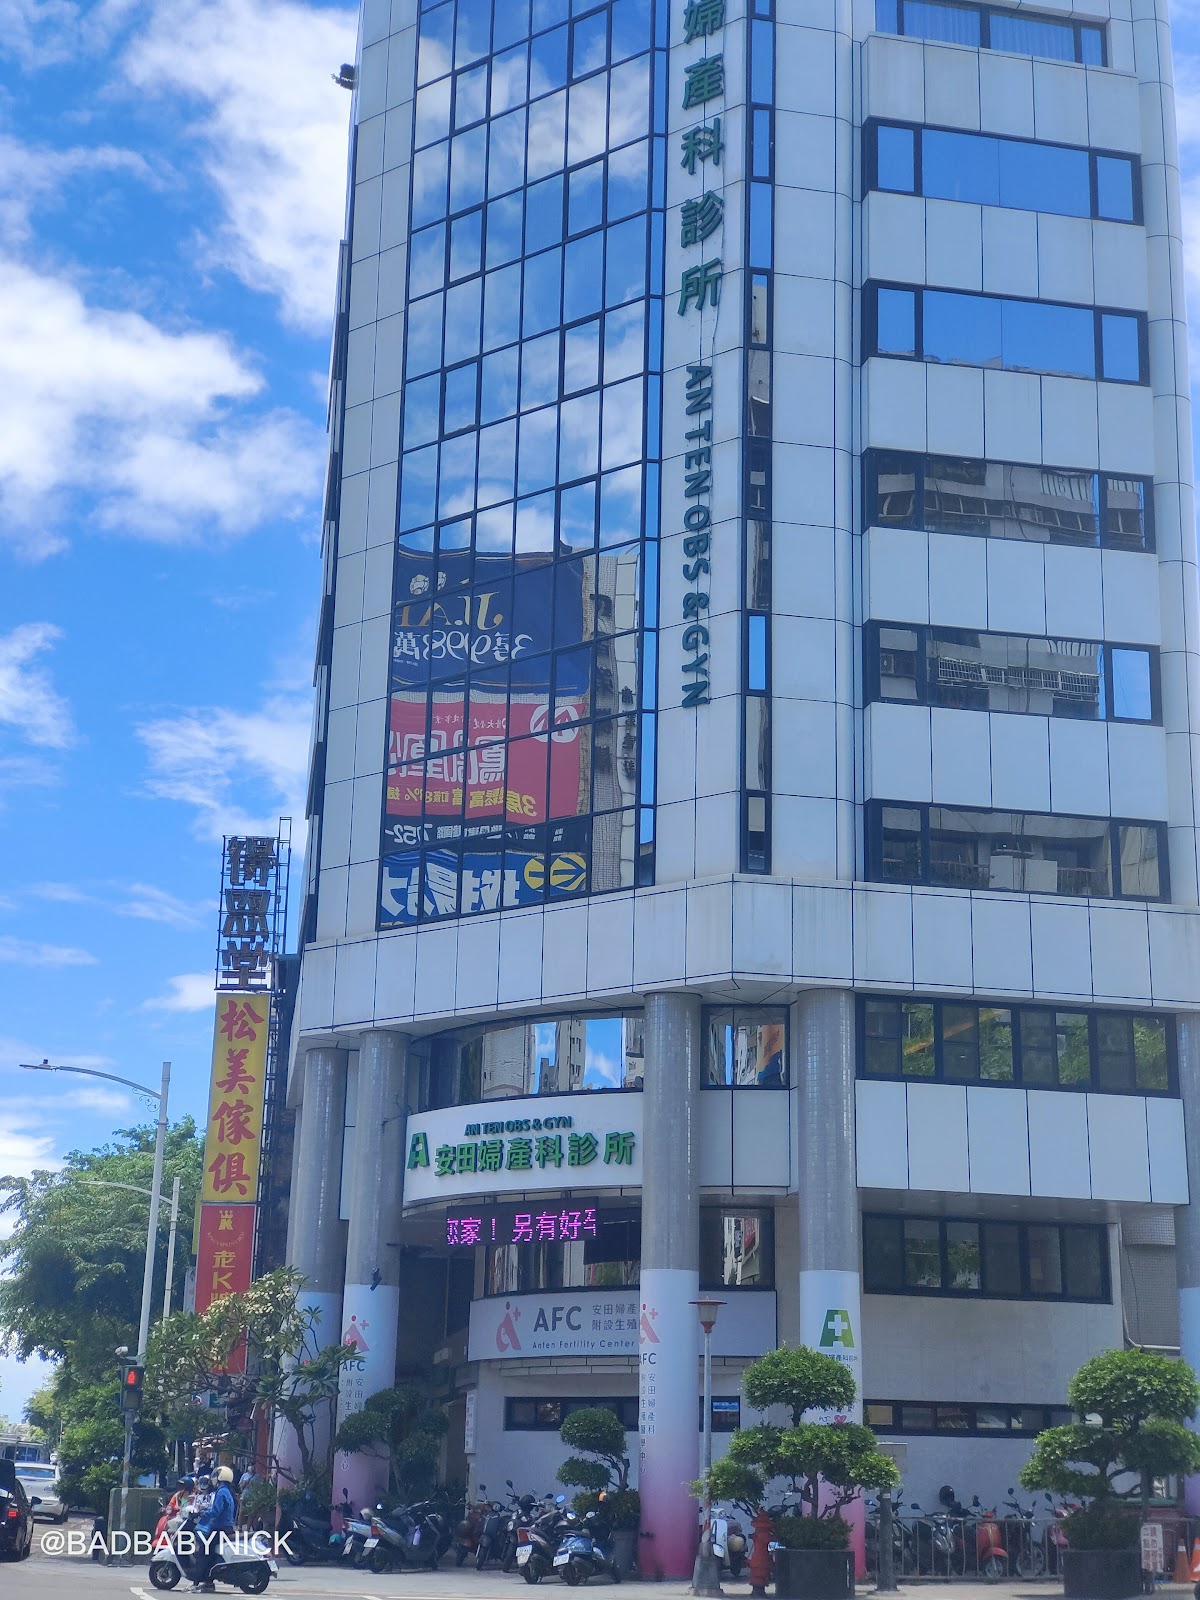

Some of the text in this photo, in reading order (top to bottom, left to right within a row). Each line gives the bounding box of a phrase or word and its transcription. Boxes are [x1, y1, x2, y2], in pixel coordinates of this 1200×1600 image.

[207, 1000, 265, 1196] 松美傢俱
[434, 1131, 635, 1176] 安田婦產科診所
[533, 1305, 582, 1332] AFC
[532, 1338, 635, 1349] Anten Fertility Center
